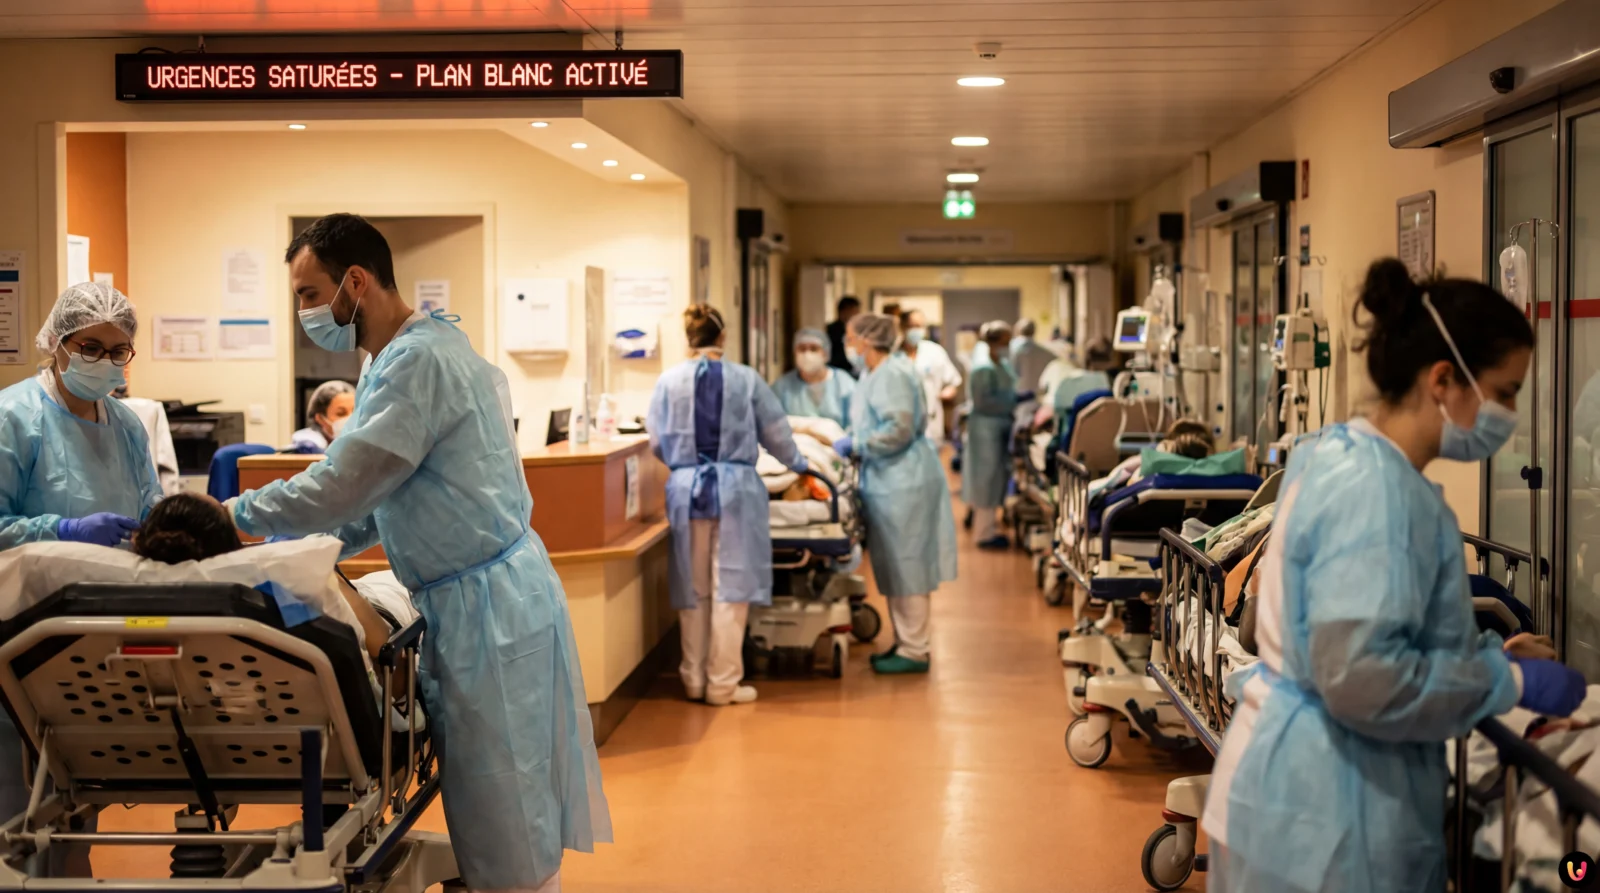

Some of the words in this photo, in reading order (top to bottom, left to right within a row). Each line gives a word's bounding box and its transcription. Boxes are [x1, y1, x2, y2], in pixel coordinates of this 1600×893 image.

[147, 65, 256, 89] URGENCES
[268, 61, 377, 88] SATURÉES
[416, 63, 472, 87] PLAN
[484, 63, 553, 87] BLANC
[565, 58, 648, 86] ACTIVÉ
